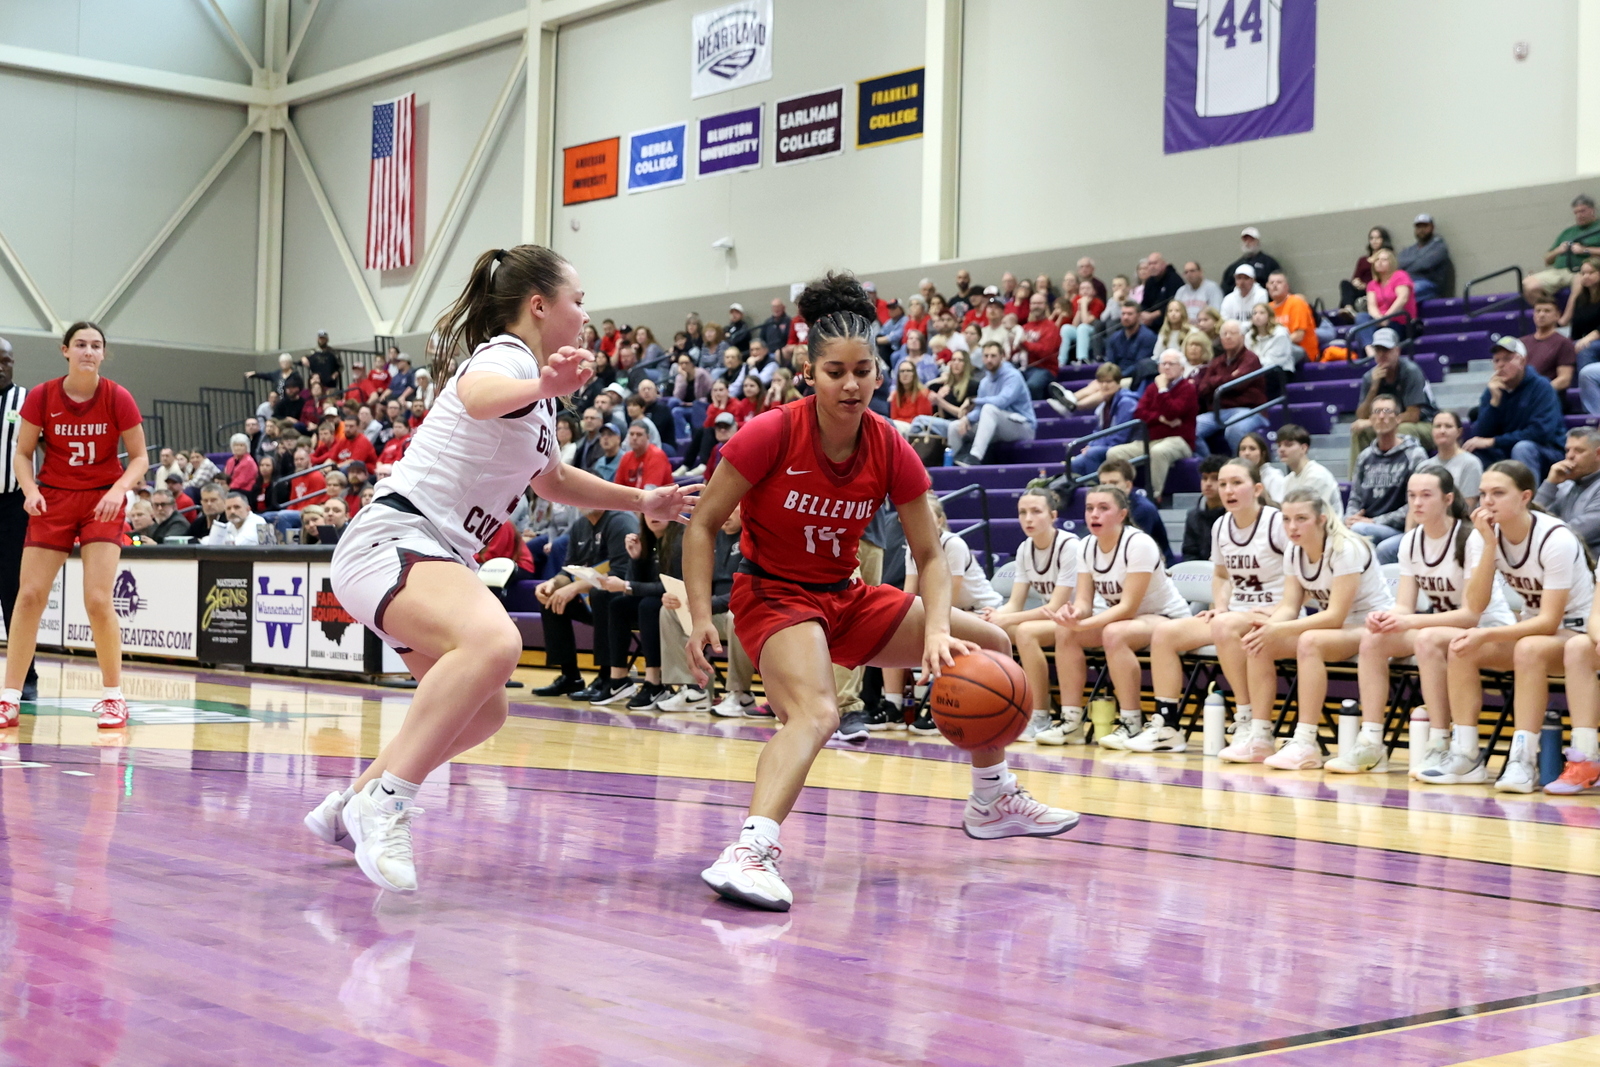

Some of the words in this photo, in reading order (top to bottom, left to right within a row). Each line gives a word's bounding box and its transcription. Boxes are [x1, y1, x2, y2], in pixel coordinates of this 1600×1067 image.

[1213, 0, 1262, 49] 44
[698, 22, 766, 64] HEARTLAND
[871, 83, 919, 107] FRANKLIN
[779, 102, 839, 130] EARLHAM
[869, 107, 918, 130] COLLEGE
[706, 121, 754, 144] BLUFFTON
[779, 127, 836, 153] COLLEGE
[640, 140, 674, 159] BEREA
[700, 138, 759, 162] UNIVERSITY
[634, 154, 678, 176] COLLEGE
[54, 423, 108, 436] BELLEVUE
[68, 441, 96, 467] 21
[783, 489, 874, 520] BELLEVUE
[803, 525, 847, 558] 14
[1225, 554, 1260, 569] GENOA
[1093, 580, 1122, 594] ENOA
[1232, 574, 1263, 591] 24
[1501, 571, 1543, 590] ENOA
[202, 585, 248, 631] SIGNS
[257, 601, 303, 616] Wannemacher
